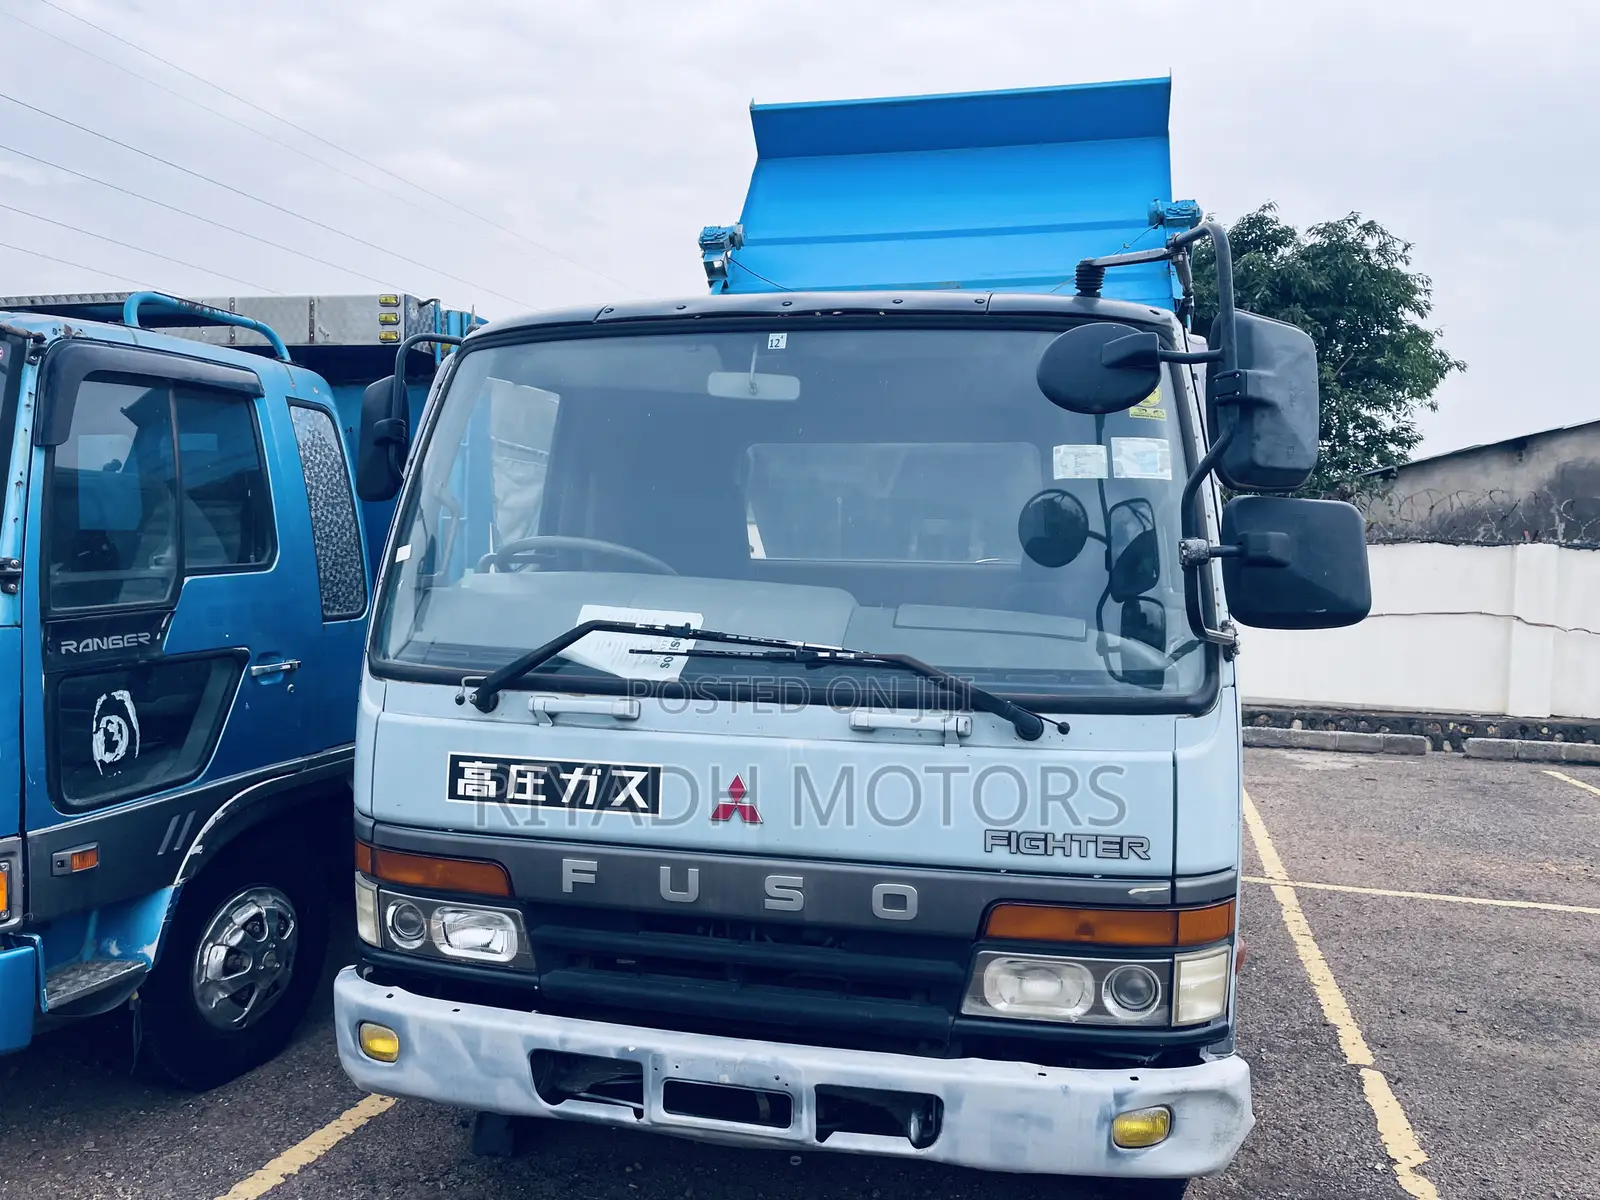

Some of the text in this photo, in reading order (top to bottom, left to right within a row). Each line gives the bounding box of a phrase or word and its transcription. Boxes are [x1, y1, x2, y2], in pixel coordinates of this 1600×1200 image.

[769, 338, 781, 348] 12
[60, 632, 151, 655] RANGER
[457, 761, 650, 809] 高圧ガス
[984, 829, 1151, 860] FIGHTER
[562, 858, 918, 921] FUSO
